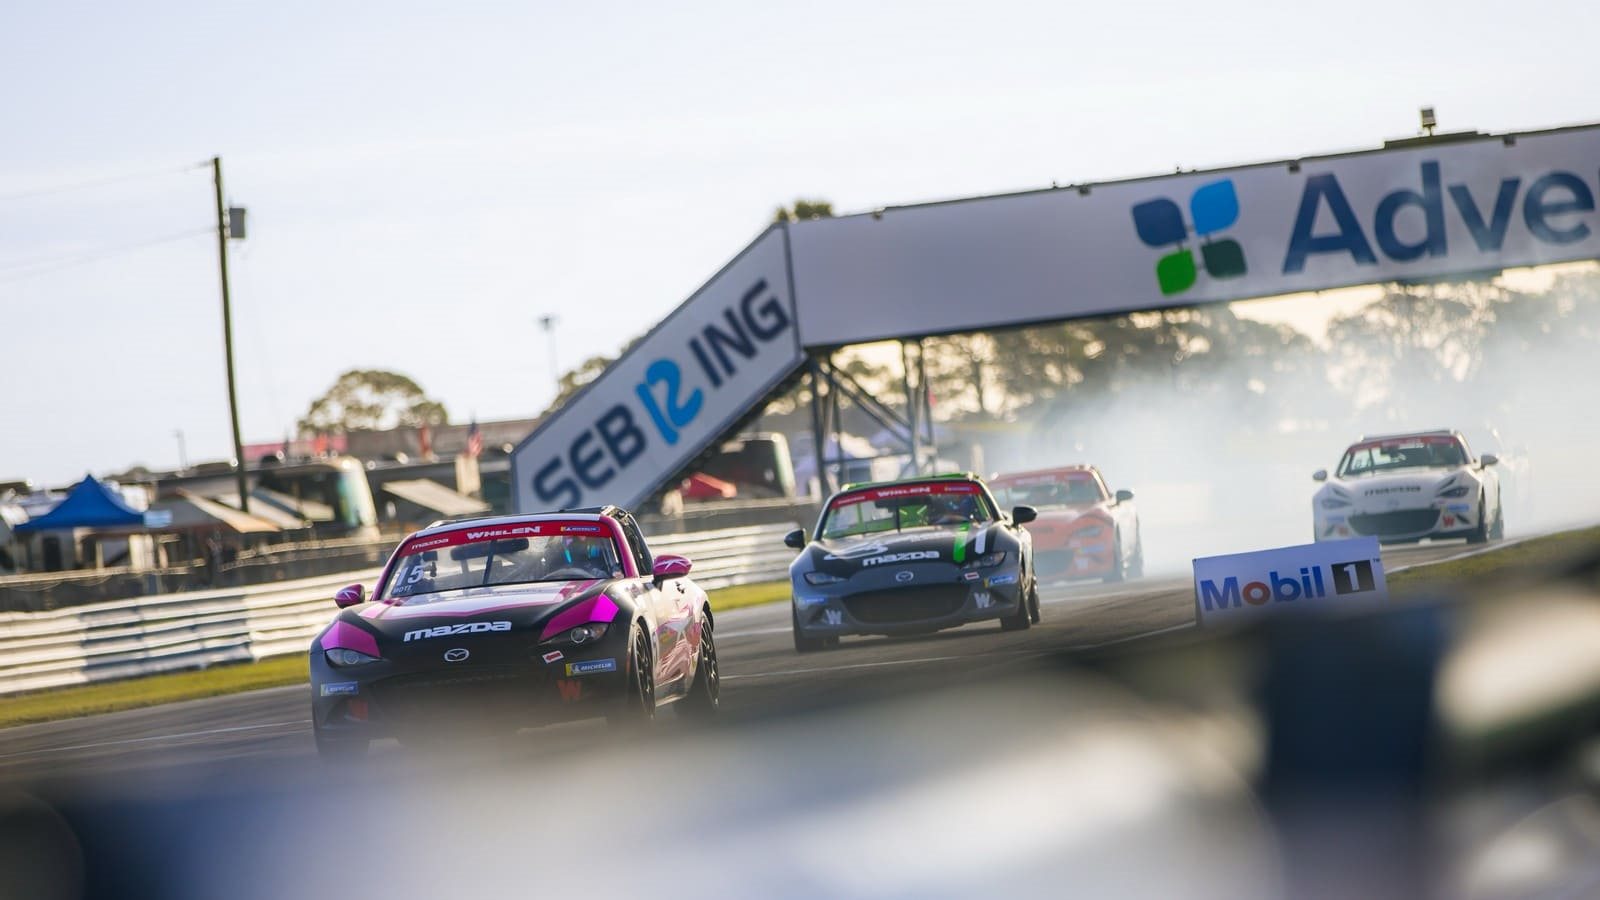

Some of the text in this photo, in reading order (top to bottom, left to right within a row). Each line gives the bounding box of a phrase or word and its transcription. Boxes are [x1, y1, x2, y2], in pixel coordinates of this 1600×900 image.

[1281, 160, 1600, 275] Adve
[466, 525, 541, 540] WHELEN
[411, 538, 450, 550] mazda
[862, 550, 940, 566] mazda
[396, 564, 424, 586] 15
[1200, 566, 1326, 612] Mobil
[1343, 563, 1359, 591] 1
[974, 592, 991, 609] W
[825, 609, 842, 625] W
[403, 621, 512, 642] mazda
